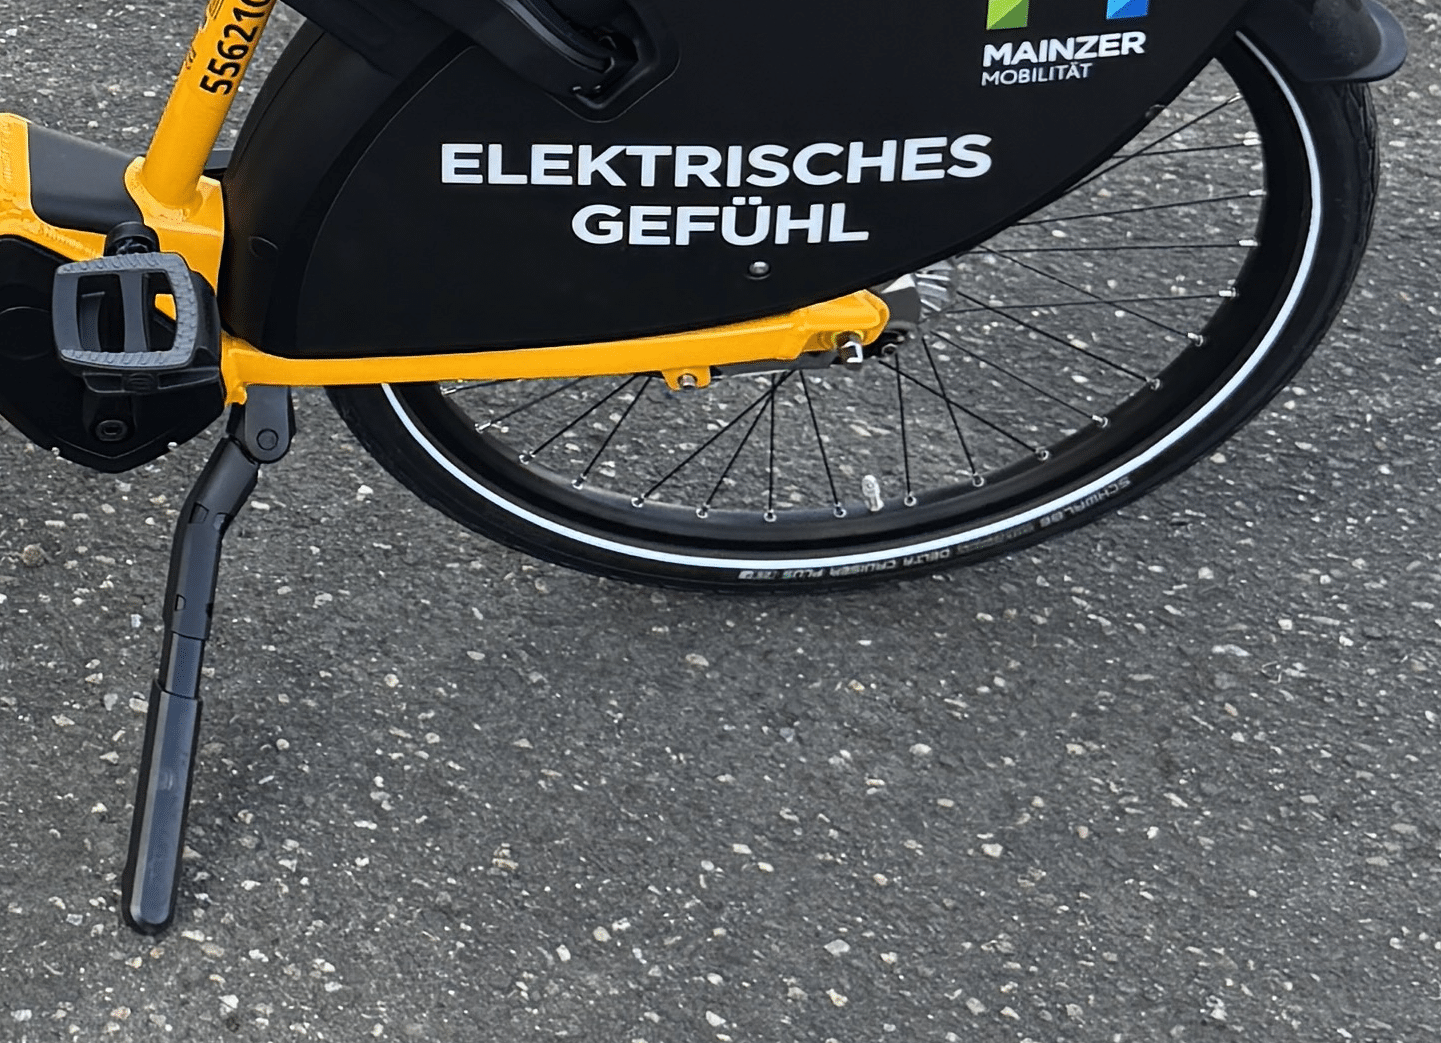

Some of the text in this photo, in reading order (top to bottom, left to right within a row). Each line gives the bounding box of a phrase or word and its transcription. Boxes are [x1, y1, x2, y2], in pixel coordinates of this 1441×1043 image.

[982, 31, 1147, 68] MAINZER
[981, 61, 1094, 87] MOBILITÄT
[441, 134, 993, 188] ELEKTRISCHES
[571, 196, 870, 247] GEFÜHL
[902, 548, 951, 567] DELTA
[782, 568, 824, 579] PLUS
